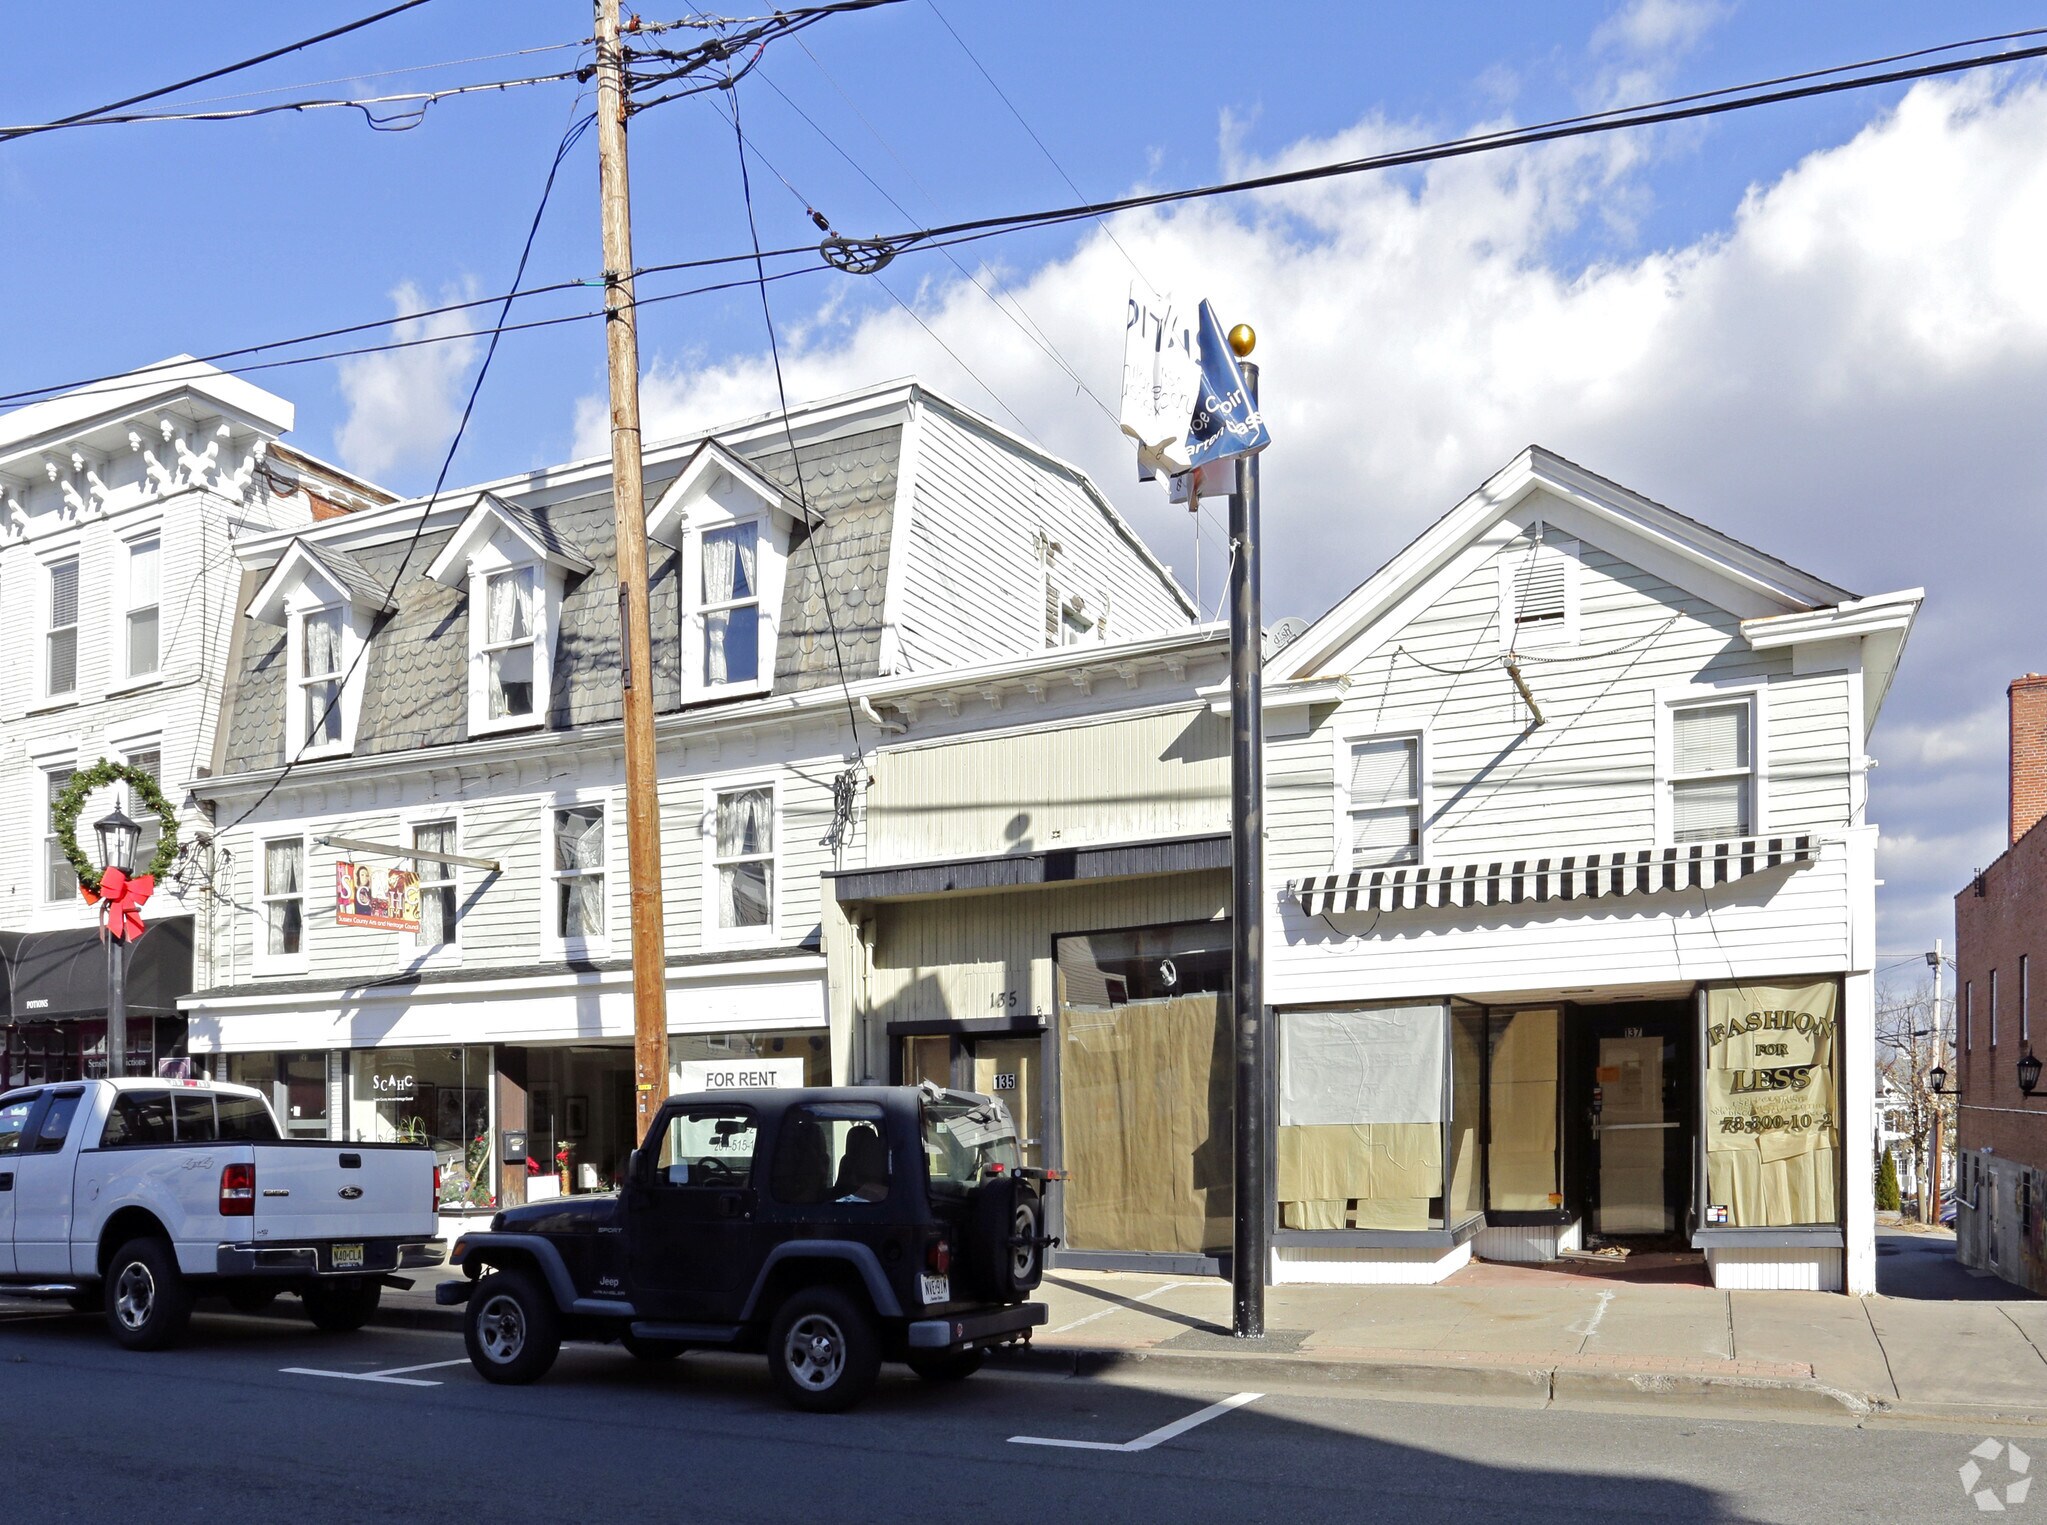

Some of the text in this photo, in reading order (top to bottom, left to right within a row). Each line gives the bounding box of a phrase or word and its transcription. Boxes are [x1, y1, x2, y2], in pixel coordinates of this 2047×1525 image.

[353, 917, 368, 926] County
[26, 998, 49, 1009] POTIONS
[990, 990, 1018, 1010] 135
[1708, 1010, 1837, 1046] FASHION
[1755, 1043, 1789, 1057] FOR
[88, 1058, 108, 1068] Sensib
[373, 1074, 413, 1092] SCAHC
[706, 1071, 777, 1087] FOR RENT
[994, 1074, 1015, 1089] 135
[1732, 1067, 1812, 1093] LESS
[600, 1276, 619, 1288] Jeep
